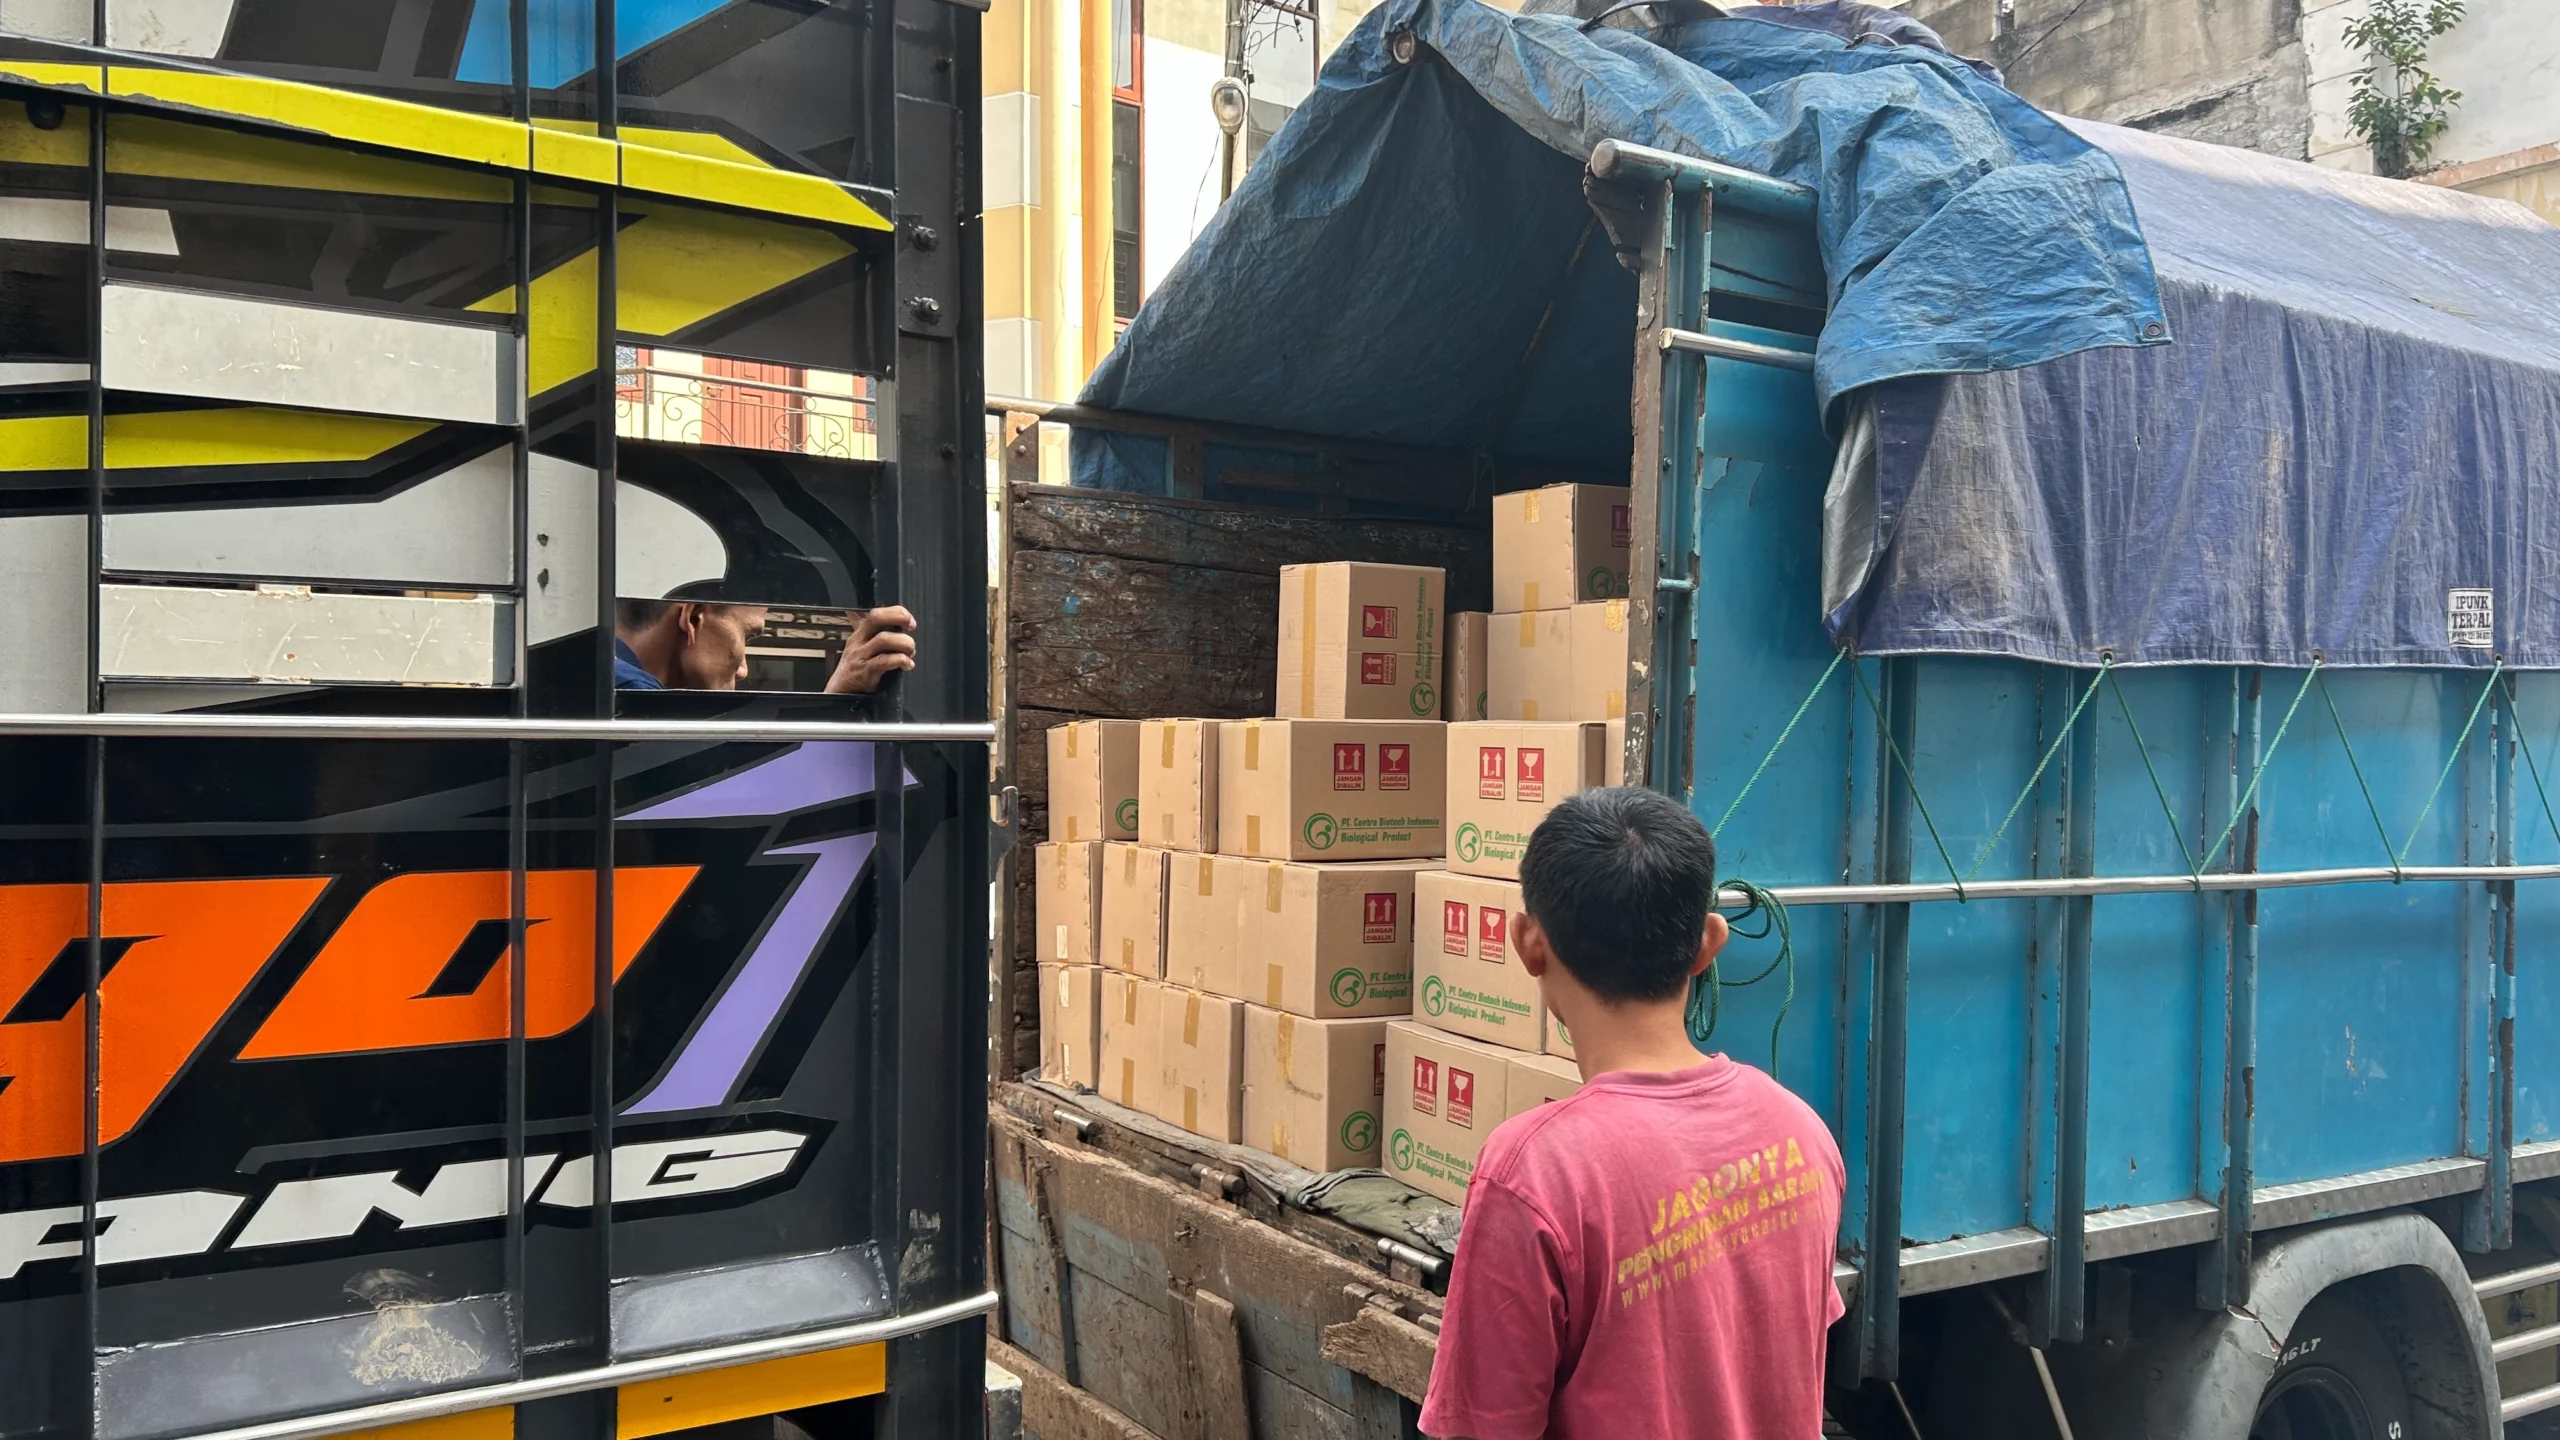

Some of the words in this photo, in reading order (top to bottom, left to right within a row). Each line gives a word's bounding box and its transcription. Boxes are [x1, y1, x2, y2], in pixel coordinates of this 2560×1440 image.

[2455, 596, 2488, 609] IPUNK
[2452, 612, 2490, 628] TERPAL
[1354, 818, 1377, 826] Centra
[1379, 818, 1405, 826] Biotech
[1407, 817, 1440, 825] Indonesia
[1341, 832, 1378, 844] Biological
[1382, 832, 1411, 841] Product
[1484, 846, 1515, 860] Biological
[1369, 987, 1407, 999] Biological
[1478, 992, 1500, 1006] Biotech
[1502, 997, 1530, 1013] Indonesia
[1448, 1002, 1477, 1018] Biological
[1480, 1010, 1505, 1025] Product
[1446, 1150, 1466, 1168] Biotech
[1416, 1158, 1444, 1179] Biological
[1448, 1171, 1468, 1189] Produc
[1651, 1137, 1805, 1236] JAGONYA
[2300, 1338, 2321, 1355] LT
